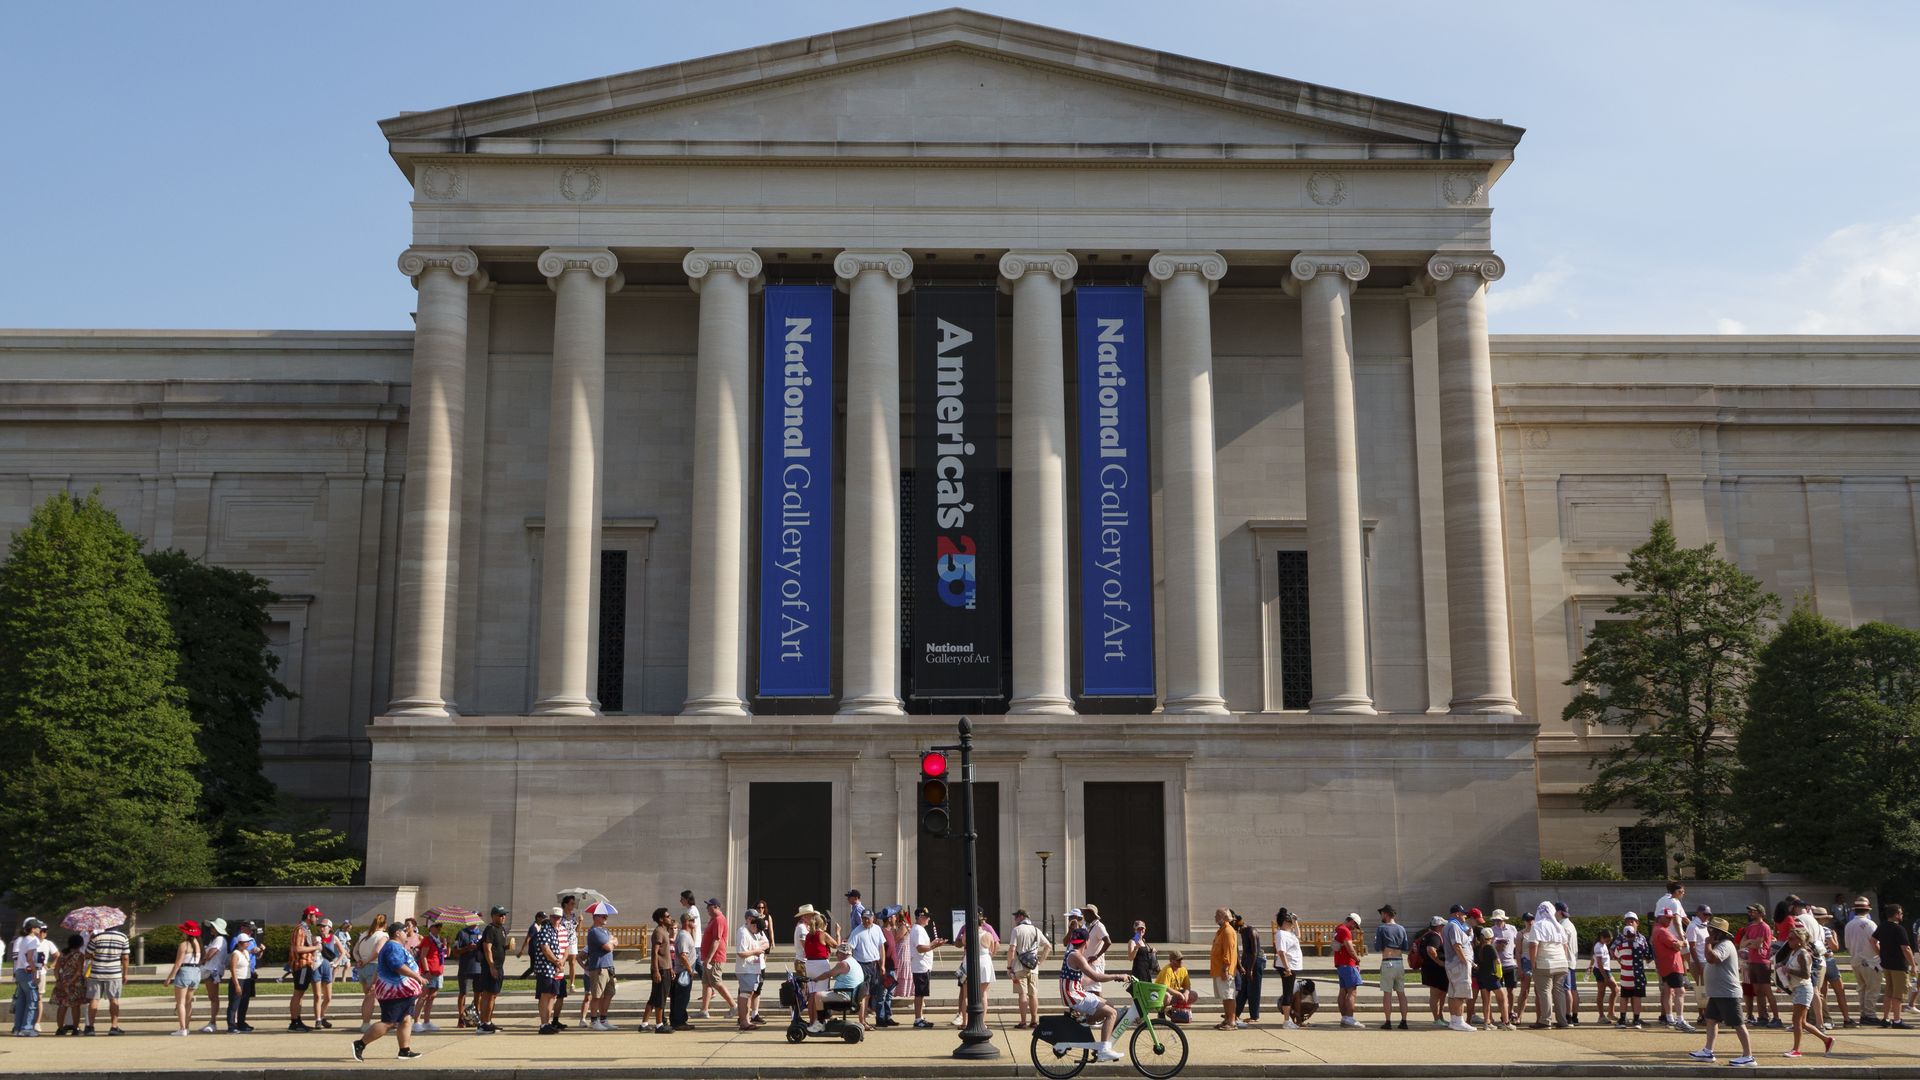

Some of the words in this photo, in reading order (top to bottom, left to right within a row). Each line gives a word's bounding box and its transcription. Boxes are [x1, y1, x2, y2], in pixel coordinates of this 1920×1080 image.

[784, 317, 813, 458] National
[1097, 317, 1127, 458] National
[936, 316, 976, 529] America's
[774, 464, 812, 576] Gallery
[1095, 464, 1129, 575] Gallery
[781, 579, 810, 612] of
[1102, 579, 1131, 612] of
[780, 613, 810, 662] Art
[925, 653, 962, 665] Gallery
[963, 653, 974, 664] of
[974, 653, 991, 664] Art
[926, 642, 974, 653] National
[1103, 612, 1132, 662] Art
[1111, 1018, 1131, 1039] Lime
